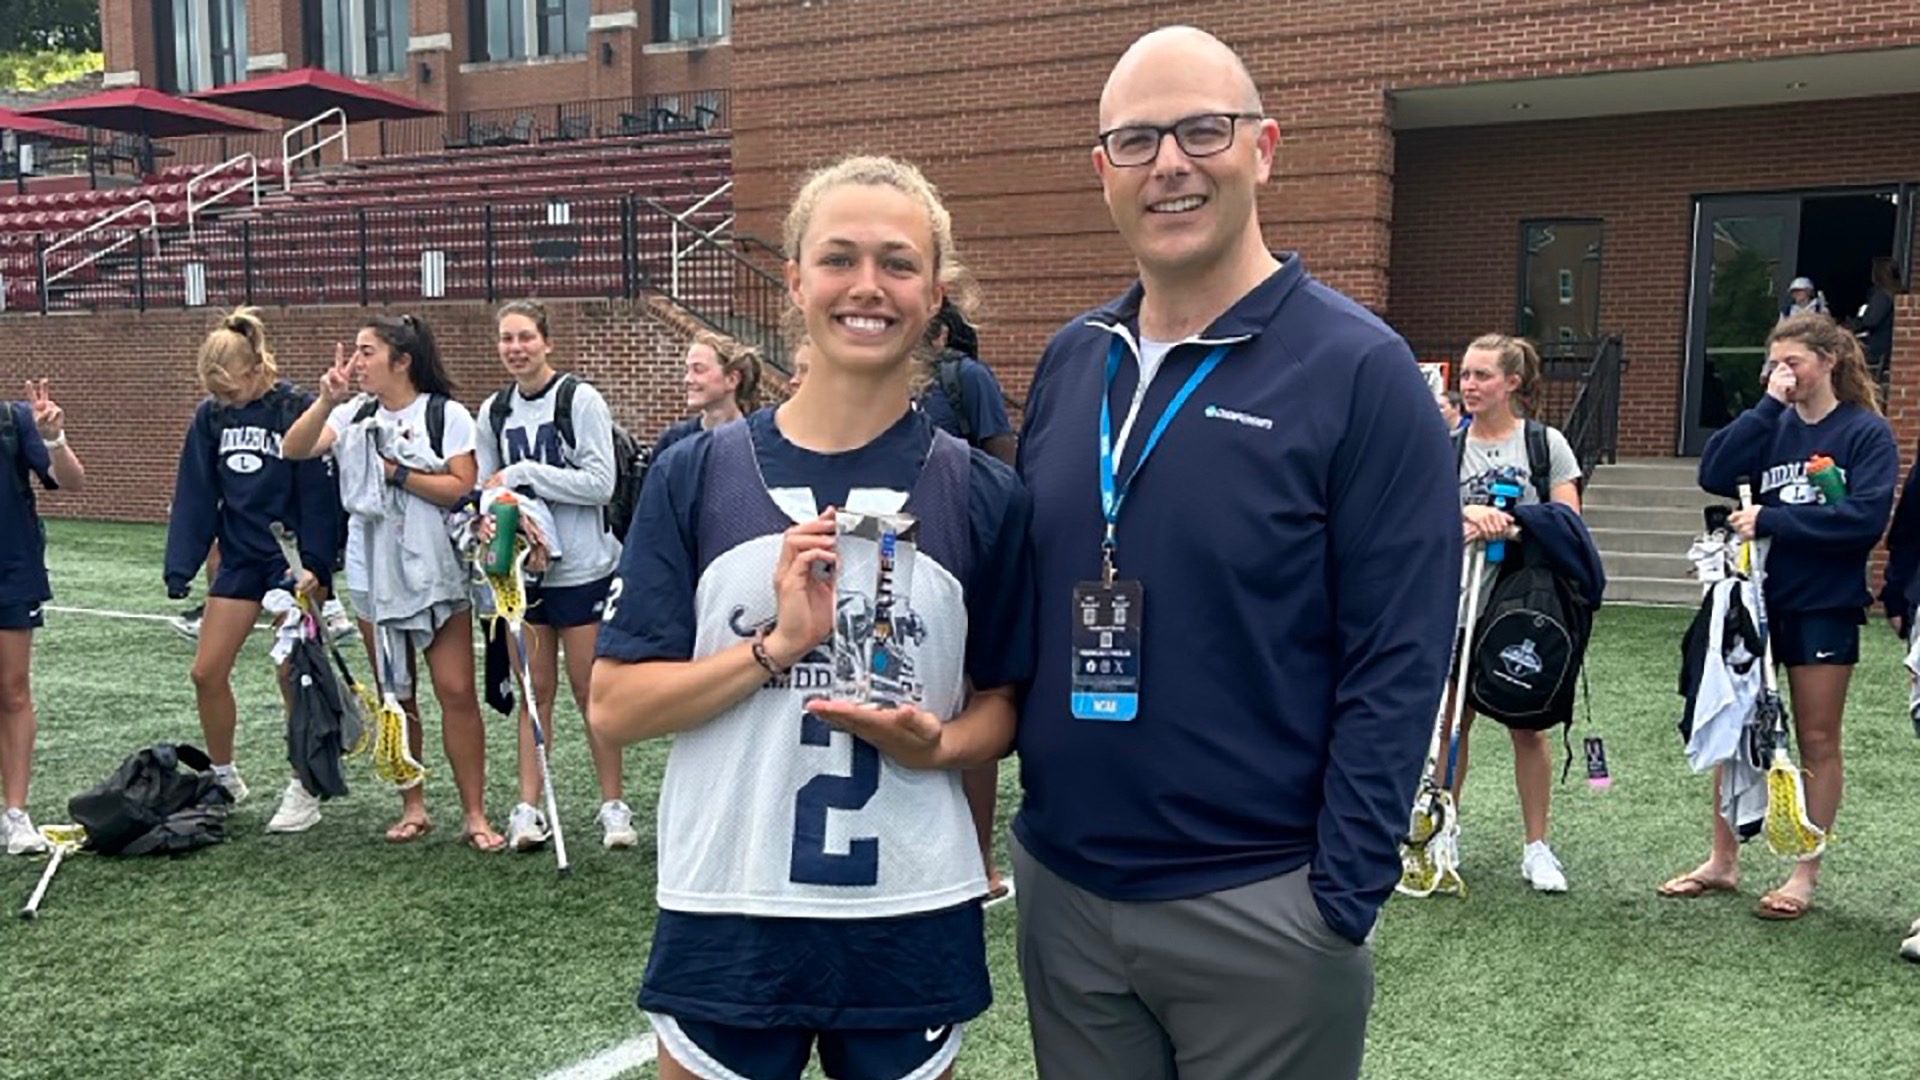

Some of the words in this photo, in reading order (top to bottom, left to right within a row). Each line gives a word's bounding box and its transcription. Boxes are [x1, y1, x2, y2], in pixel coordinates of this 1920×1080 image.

[506, 421, 566, 469] M
[602, 576, 624, 621] 2
[790, 693, 880, 887] 2
